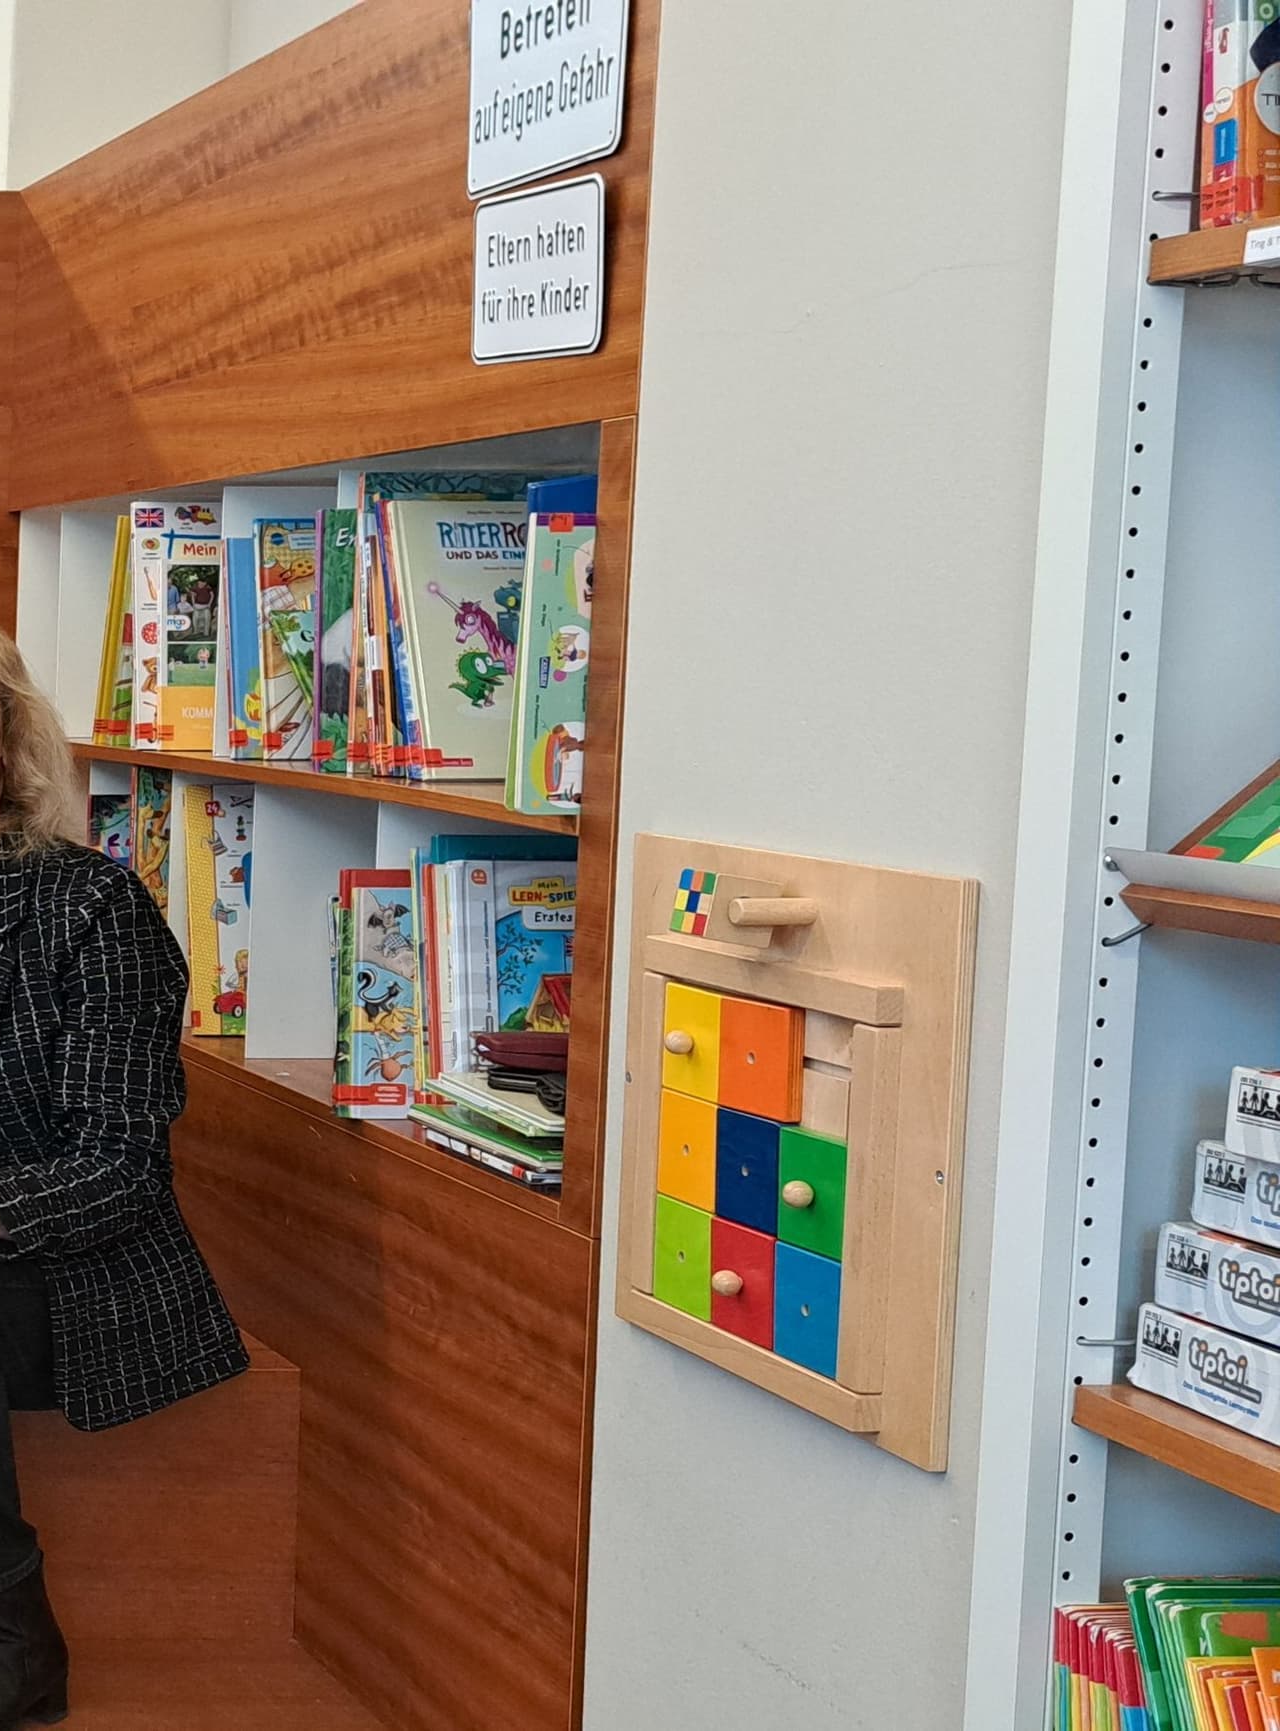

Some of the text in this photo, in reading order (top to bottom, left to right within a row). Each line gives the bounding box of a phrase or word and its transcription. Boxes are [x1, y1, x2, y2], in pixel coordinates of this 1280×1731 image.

[501, 0, 590, 59] Betreten
[475, 47, 614, 144] auf eigene Gefahr
[488, 223, 585, 268] Eltern haften
[482, 277, 590, 324] für ihre Kinder
[183, 542, 217, 557] Mein
[446, 550, 472, 560] UND
[475, 550, 499, 560] DAS
[535, 911, 573, 923] Erstes
[1220, 1259, 1280, 1303] tiptoi
[1190, 1337, 1248, 1384] tiptoi
